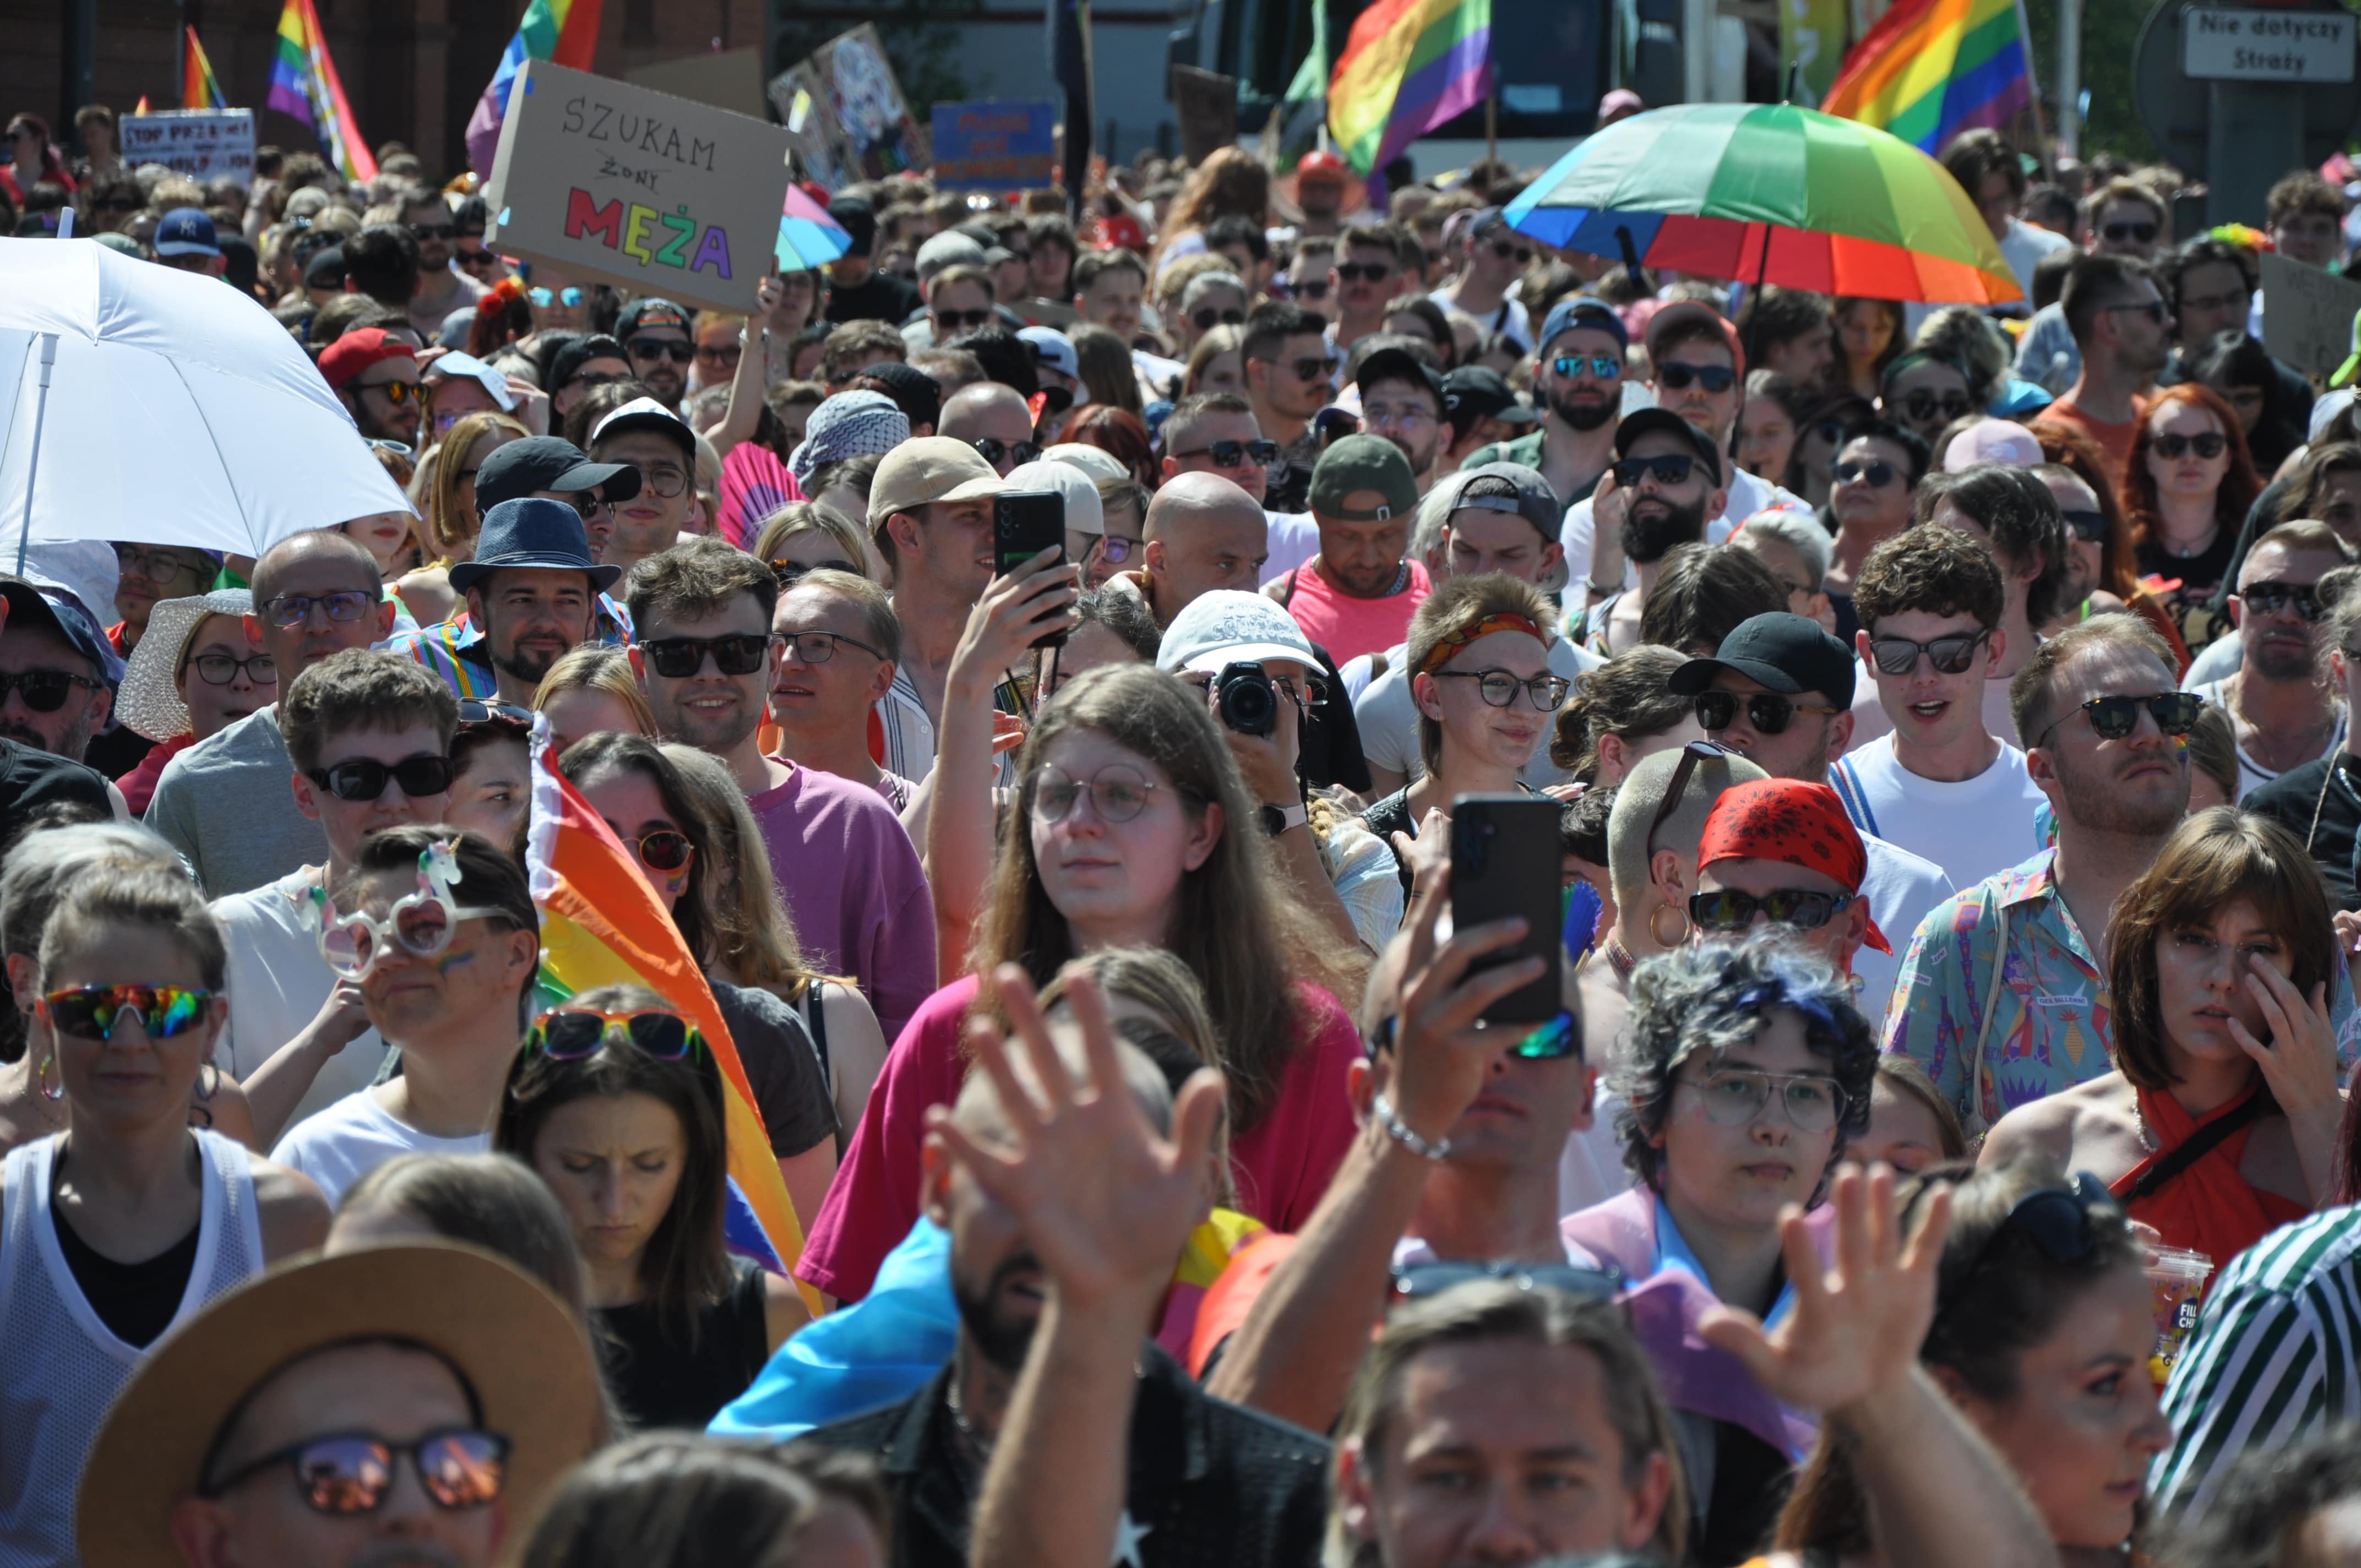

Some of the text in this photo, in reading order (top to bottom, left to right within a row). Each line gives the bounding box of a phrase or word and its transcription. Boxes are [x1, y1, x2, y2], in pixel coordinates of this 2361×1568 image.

[2199, 13, 2343, 43] Nie dotyczy
[2233, 46, 2307, 78] Straży
[124, 126, 164, 145] STOP
[562, 95, 715, 172] SZUKAM
[563, 186, 732, 280] MĘŻA
[2180, 1304, 2197, 1317] FILL
